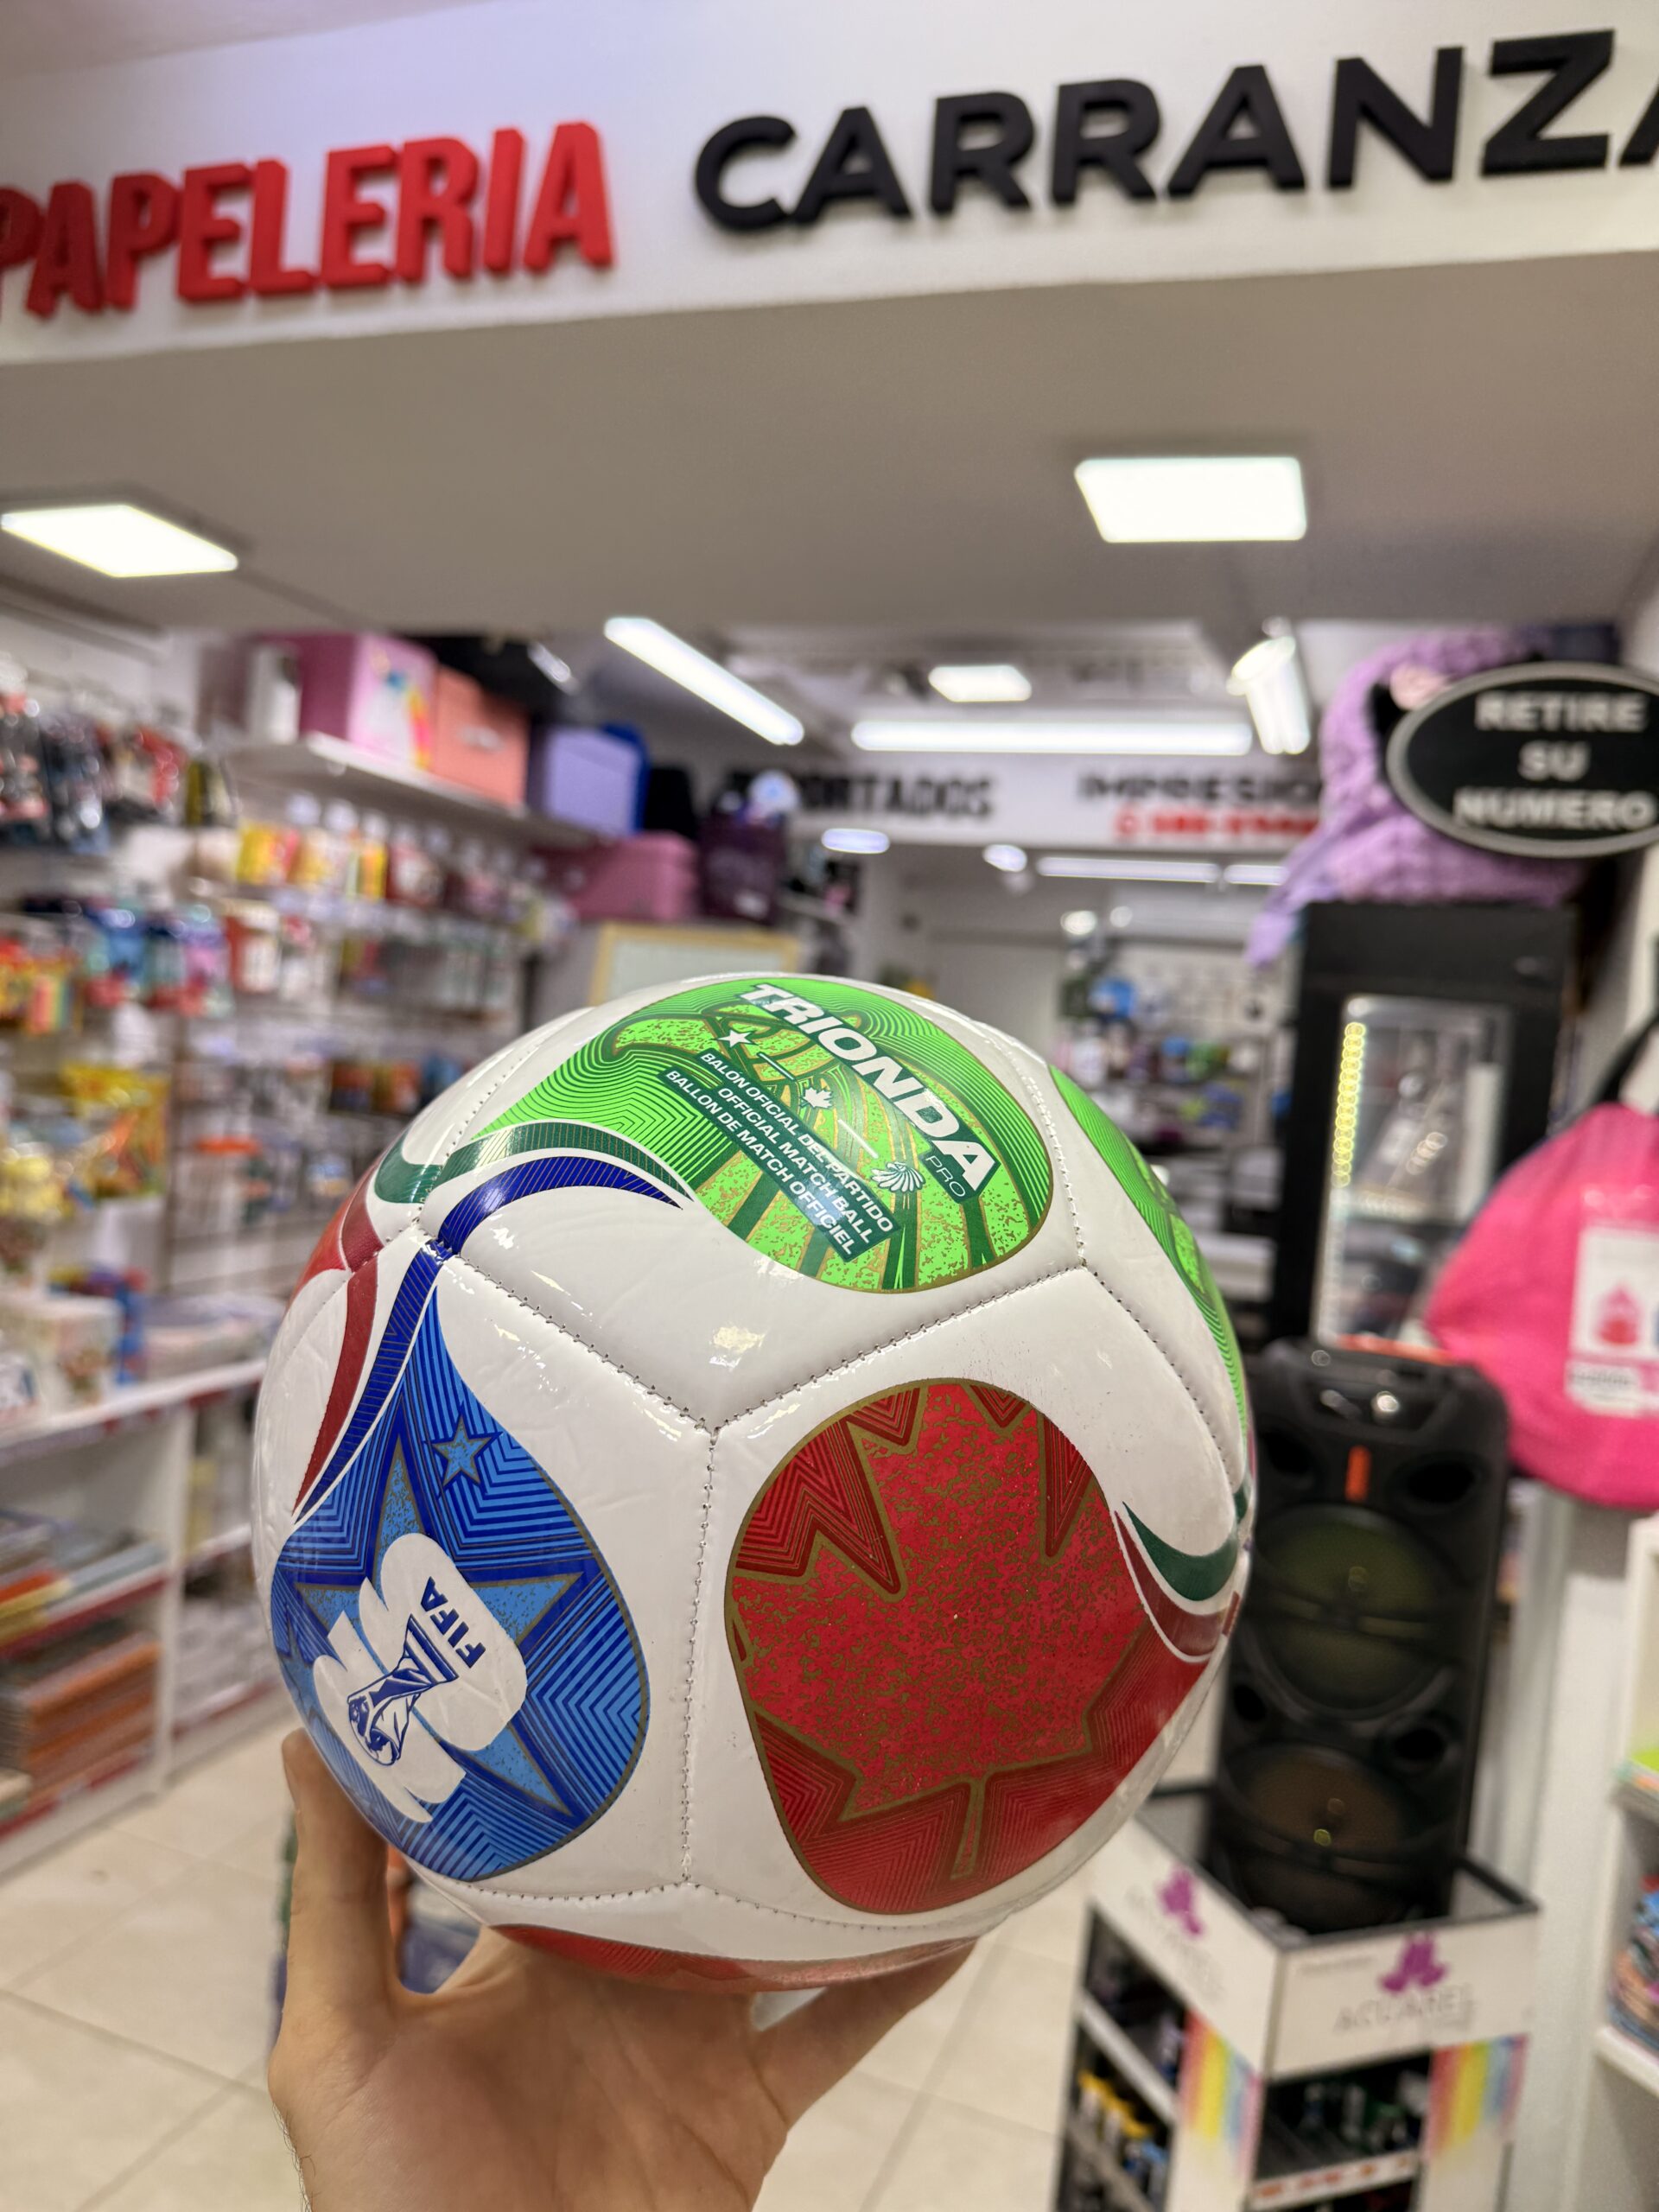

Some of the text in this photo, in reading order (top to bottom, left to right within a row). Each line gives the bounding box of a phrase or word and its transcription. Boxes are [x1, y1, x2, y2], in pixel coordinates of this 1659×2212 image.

[0, 29, 1659, 318] PAPELERIA CARRANZ
[1474, 691, 1647, 733] RETIRE
[1517, 740, 1591, 781] SU
[1453, 786, 1657, 831] NUMERO
[741, 983, 996, 1192] TRIONDA
[665, 1070, 855, 1255] BALLON DE MATCH OFFICIEL
[717, 1086, 874, 1244] OFFICIAL MATCH BALL
[745, 1084, 800, 1135] OFICIAL
[798, 1133, 827, 1163] DEL
[825, 1160, 893, 1232] PARTIDO
[925, 1154, 966, 1198] PRO
[420, 1575, 486, 1669] FIFA
